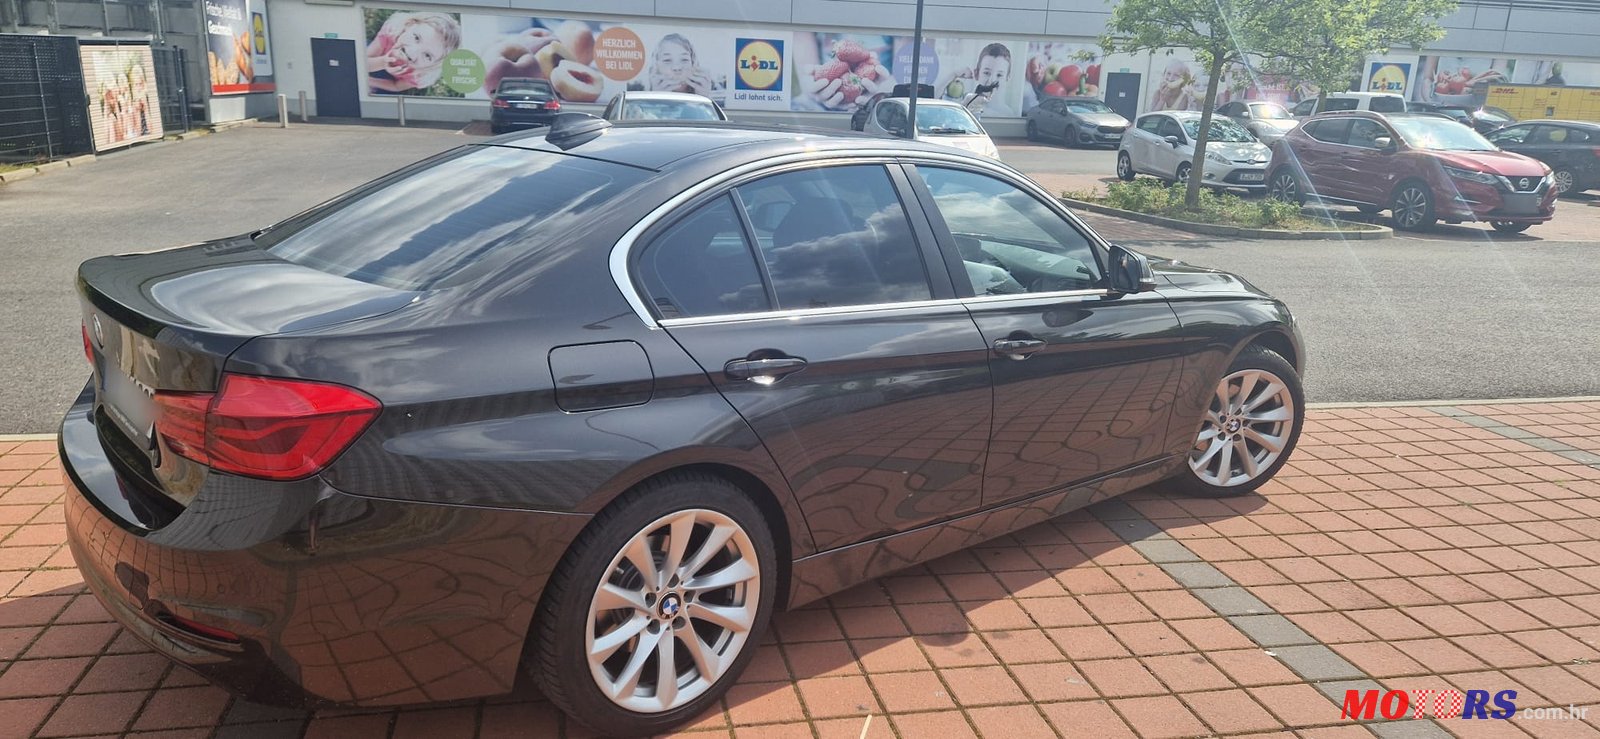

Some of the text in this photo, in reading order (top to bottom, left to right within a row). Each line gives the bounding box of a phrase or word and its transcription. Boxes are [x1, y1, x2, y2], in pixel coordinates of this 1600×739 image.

[603, 38, 636, 48] HERZLICH
[595, 49, 643, 60] WILLKOMMEN
[605, 60, 634, 70] BEI LIDL
